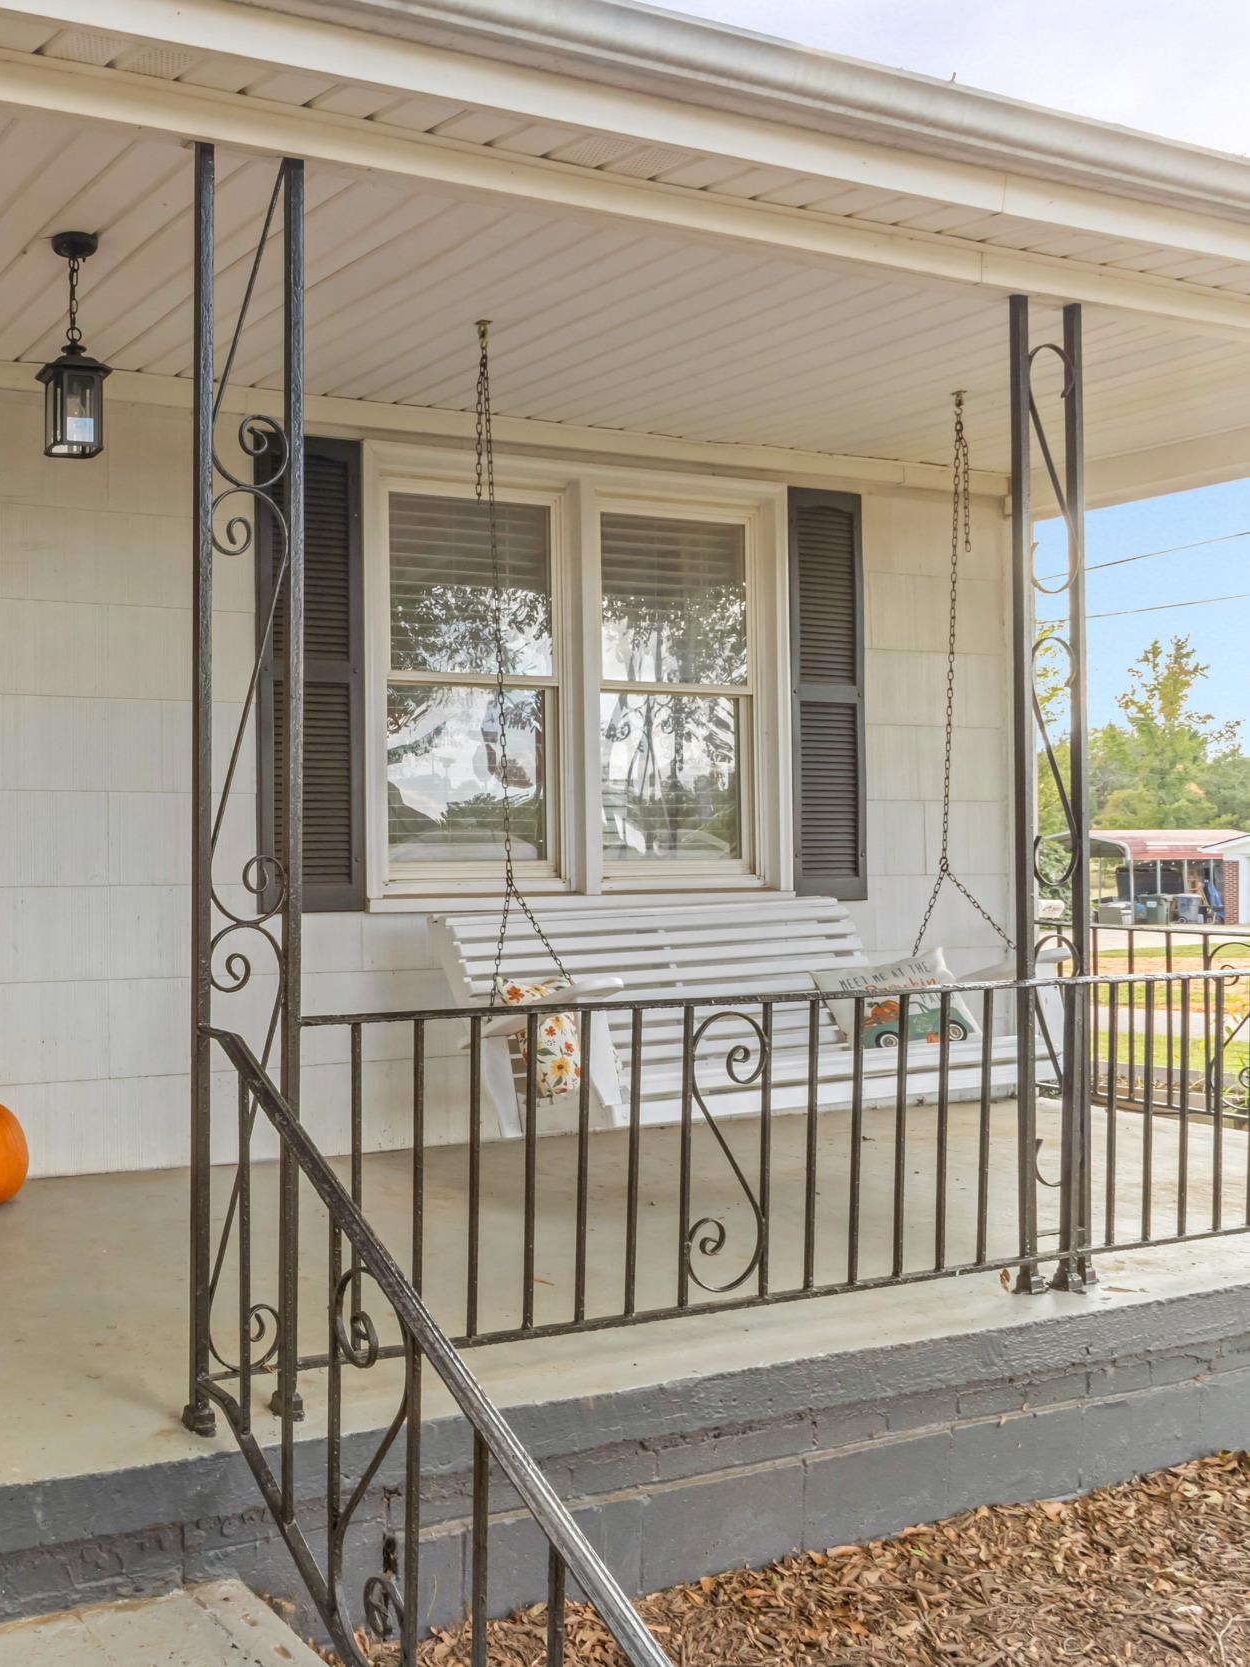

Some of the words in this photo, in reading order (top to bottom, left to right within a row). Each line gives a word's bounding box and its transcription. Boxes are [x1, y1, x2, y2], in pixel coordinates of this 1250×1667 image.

[839, 975, 868, 992] MEET
[872, 973, 888, 984] ME
[891, 967, 905, 979] AT
[909, 961, 931, 975] THE
